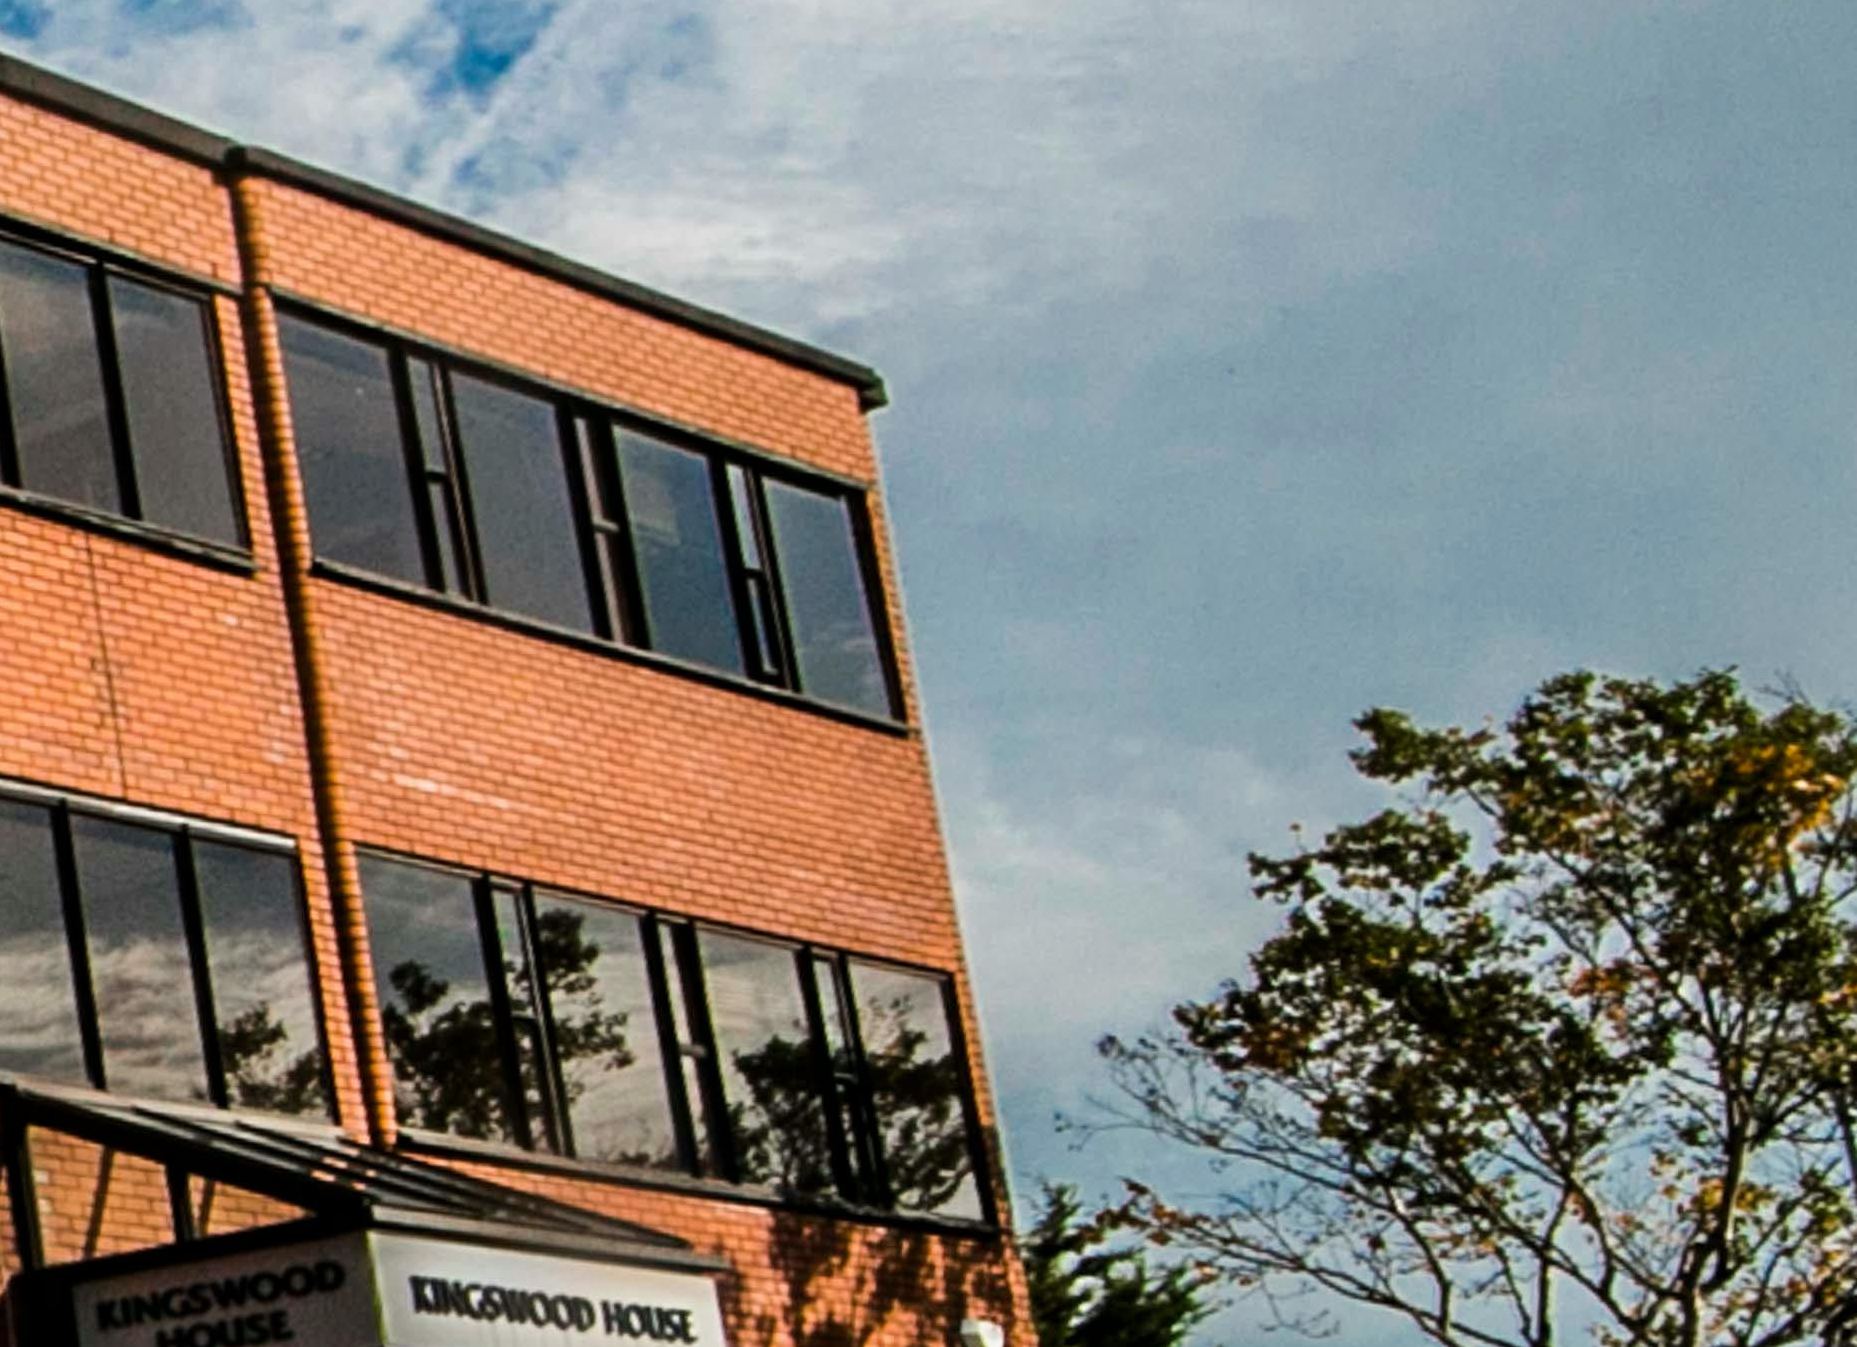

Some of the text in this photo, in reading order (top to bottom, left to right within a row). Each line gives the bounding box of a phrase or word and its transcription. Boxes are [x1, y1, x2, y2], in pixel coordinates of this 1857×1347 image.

[96, 1260, 346, 1332] KINGSWOOD
[408, 1275, 699, 1345] KINGSWOOD HOUSE
